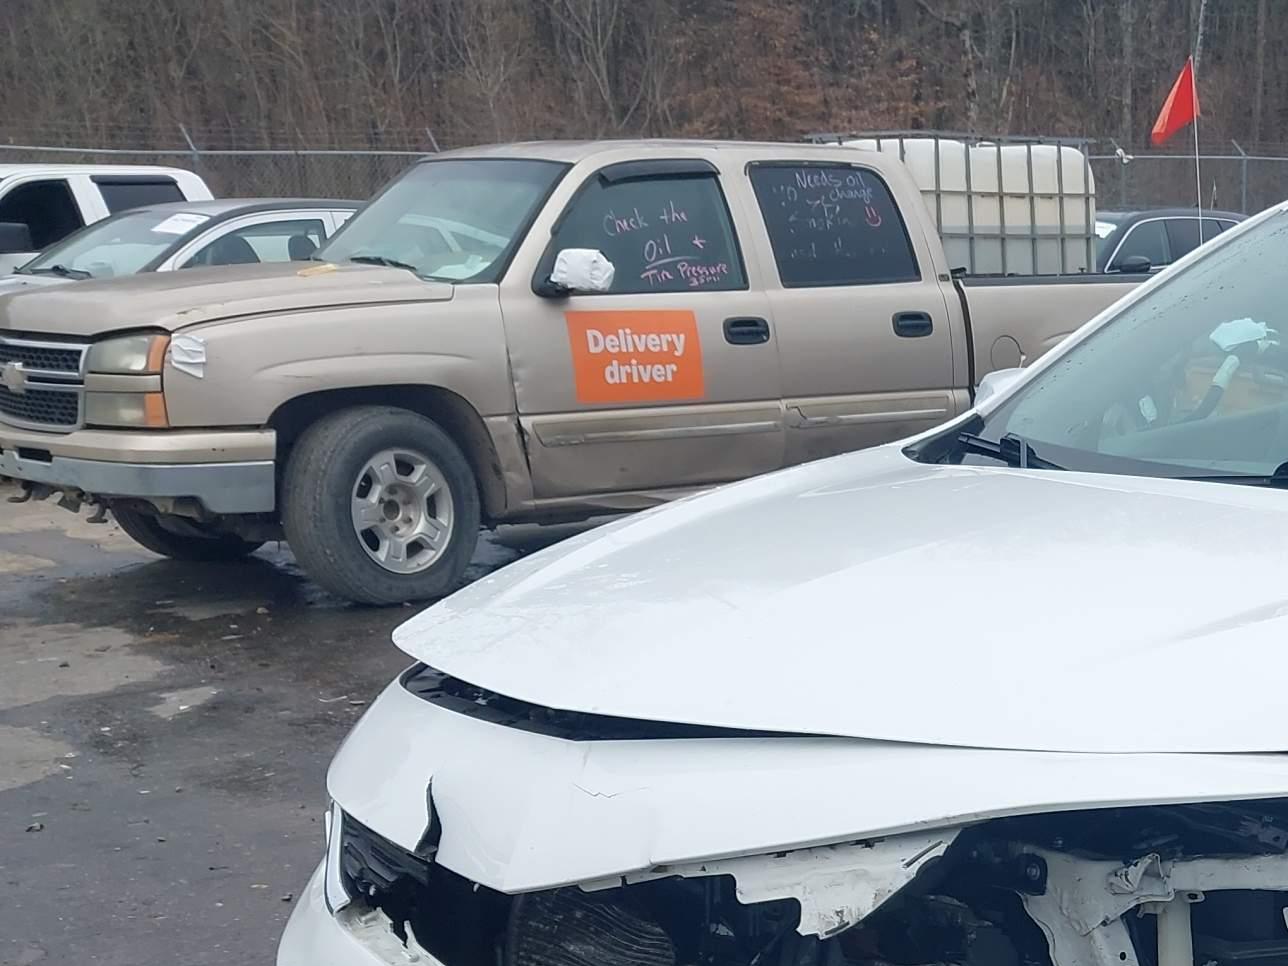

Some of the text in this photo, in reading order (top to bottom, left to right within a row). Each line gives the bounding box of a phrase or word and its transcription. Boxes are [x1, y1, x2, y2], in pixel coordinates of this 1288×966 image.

[795, 170, 865, 189] Needs oil
[603, 199, 688, 237] Check the
[644, 233, 671, 262] Oil
[677, 261, 729, 279] Pressure
[585, 327, 686, 357] Delivery
[604, 358, 678, 385] driver
